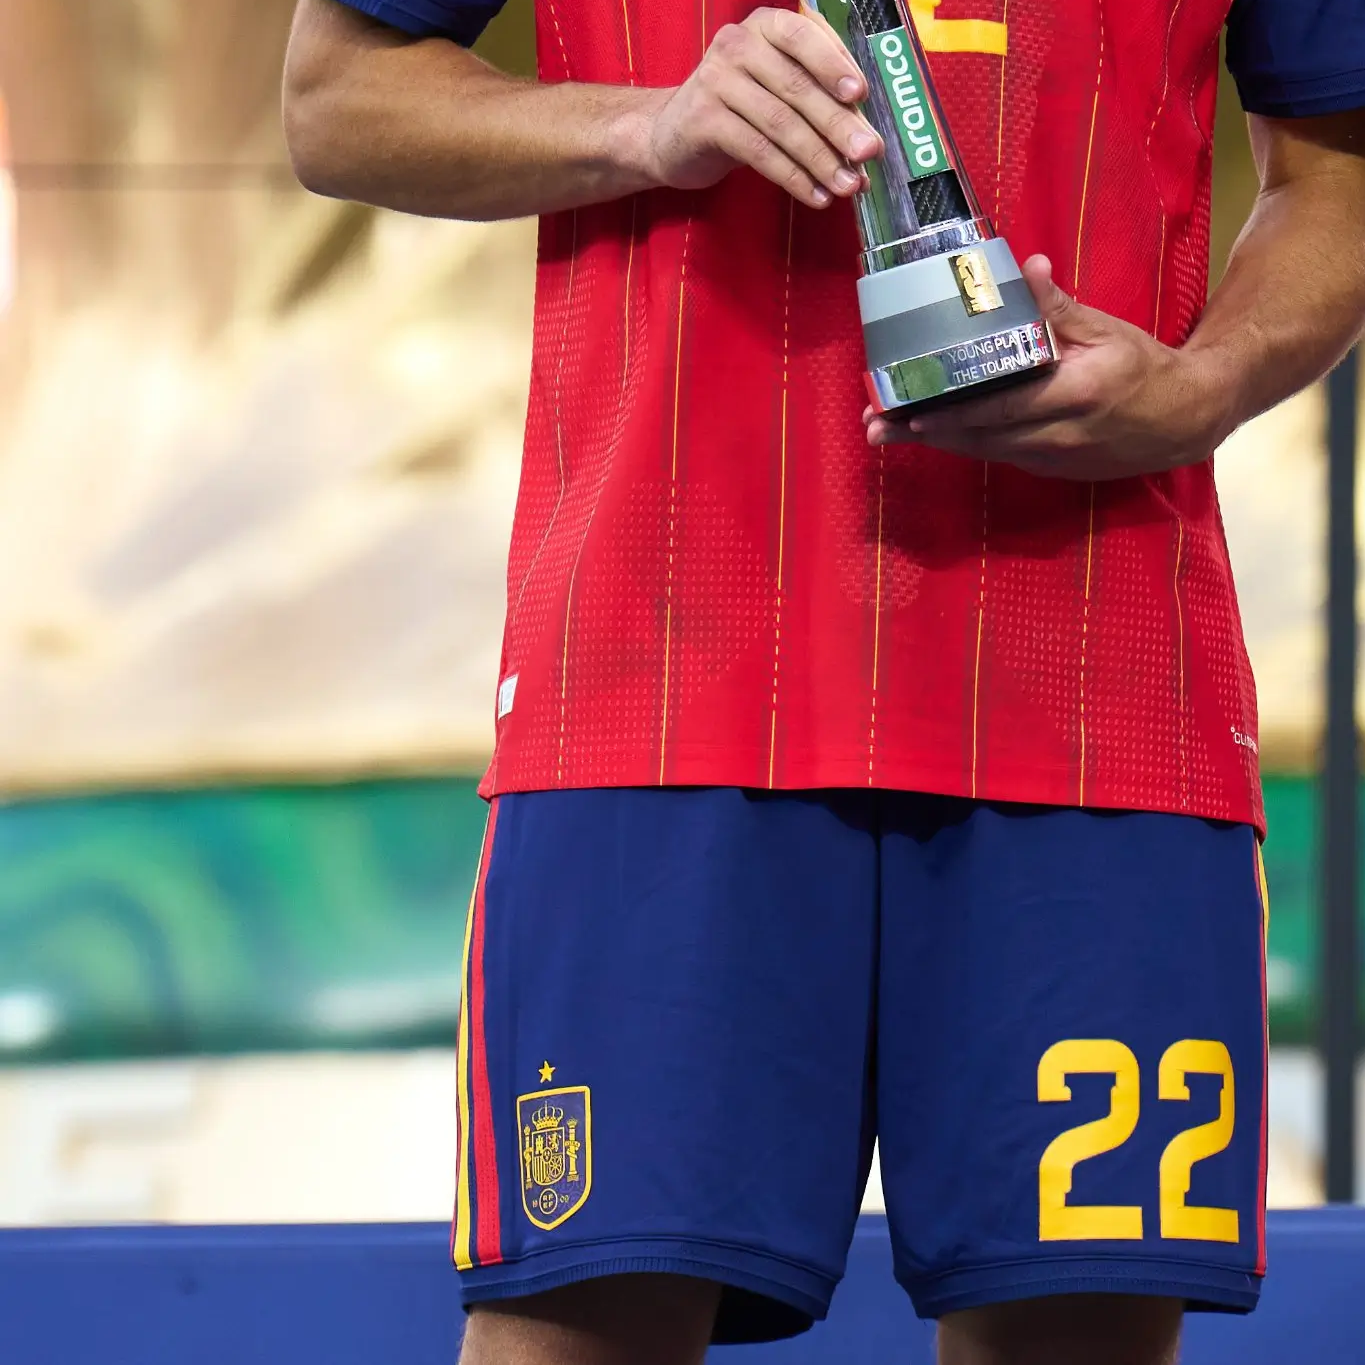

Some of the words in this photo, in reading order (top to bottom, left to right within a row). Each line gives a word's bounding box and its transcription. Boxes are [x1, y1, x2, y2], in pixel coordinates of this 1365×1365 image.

[881, 34, 938, 169] aramco
[948, 341, 994, 363] YOUNG
[1033, 326, 1043, 339] OF
[953, 366, 980, 384] THE
[980, 346, 1051, 374] TOURNAMENT
[1037, 1039, 1239, 1243] 22
